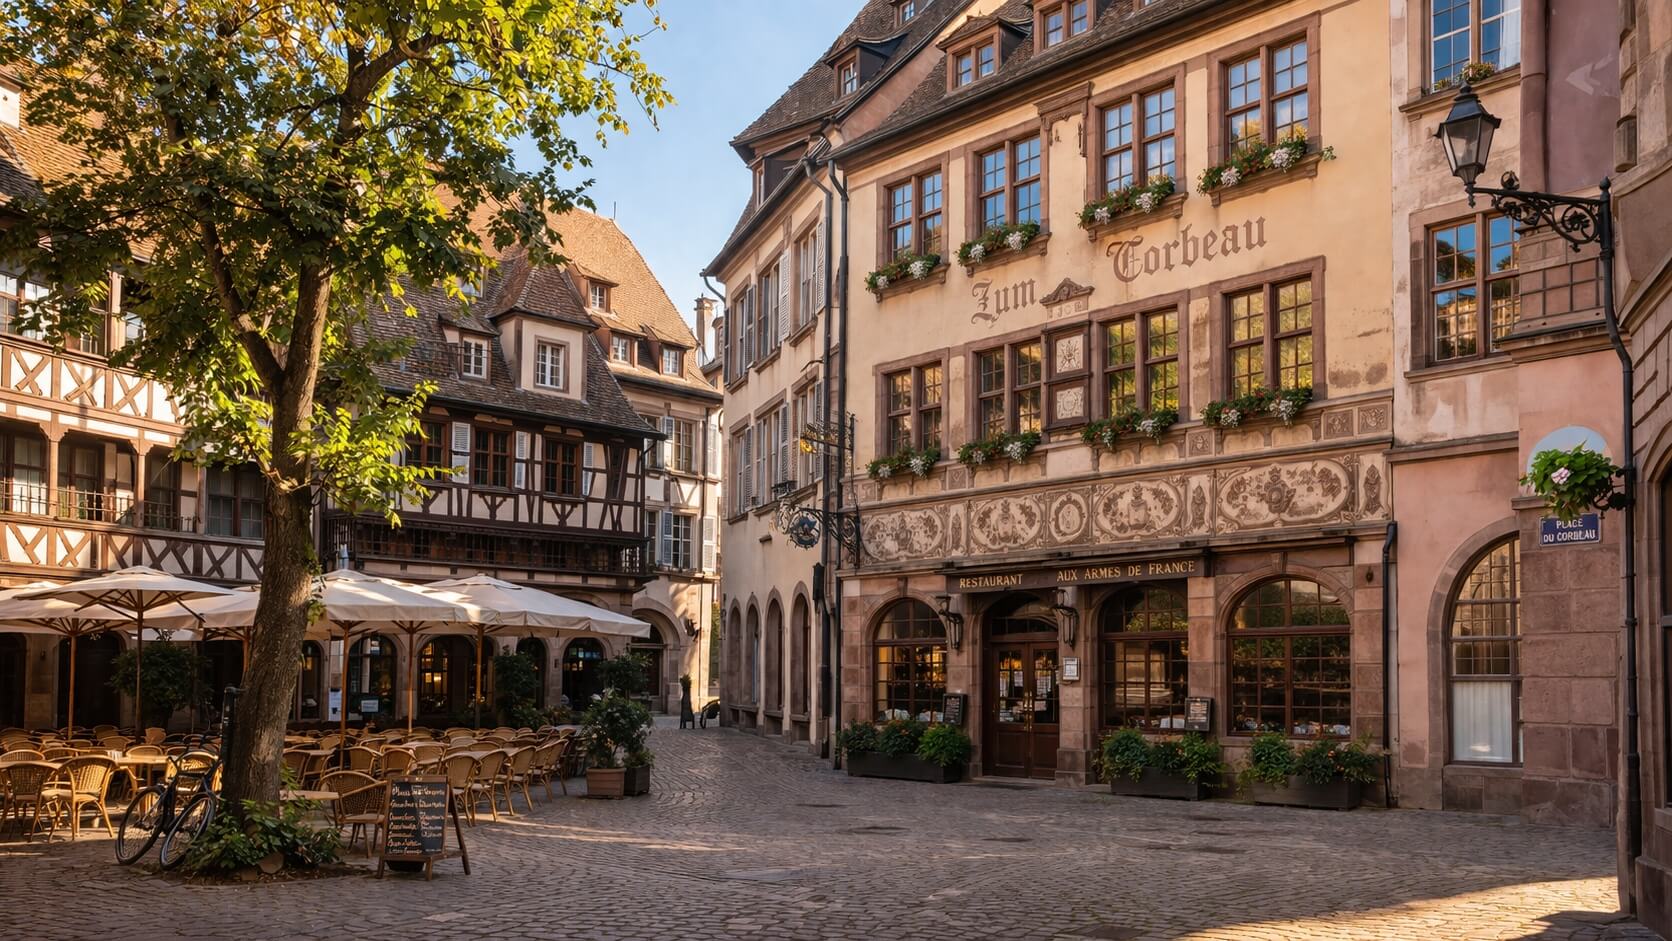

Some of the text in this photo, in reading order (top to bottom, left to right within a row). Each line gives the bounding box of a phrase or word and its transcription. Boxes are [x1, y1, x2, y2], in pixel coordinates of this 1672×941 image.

[971, 278, 1036, 327] Zum
[1556, 518, 1584, 529] PLACE
[1543, 534, 1555, 543] DU
[959, 560, 1195, 588] RESTAURANT AUX ARMES DE FRANCE
